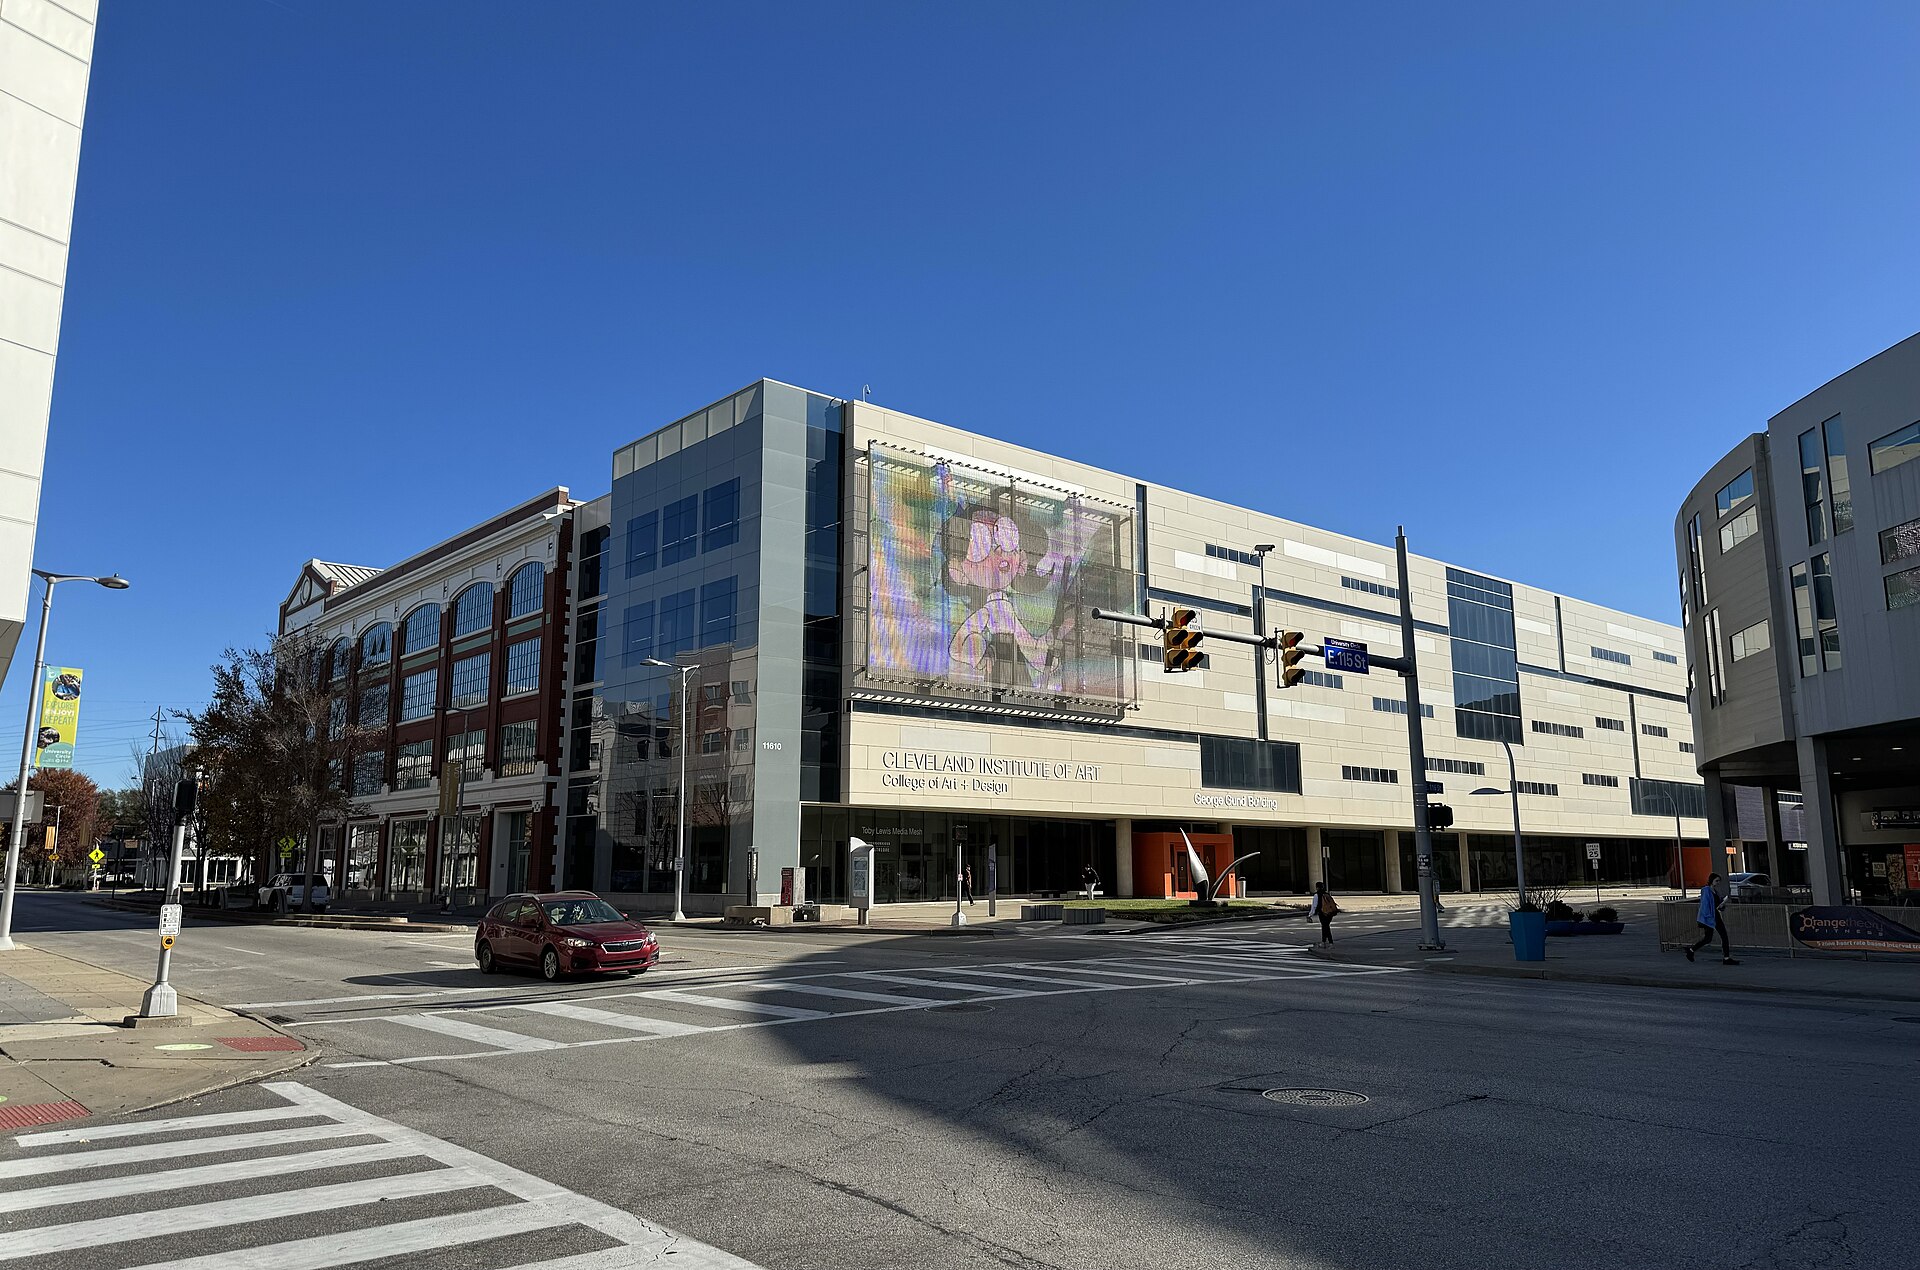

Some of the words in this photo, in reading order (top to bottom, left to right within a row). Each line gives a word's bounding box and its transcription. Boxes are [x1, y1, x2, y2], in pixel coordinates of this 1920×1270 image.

[1354, 654, 1367, 670] St
[44, 715, 74, 725] REPEAT!
[762, 742, 782, 750] 11610
[882, 751, 974, 773] CLEVELAND
[979, 757, 1050, 778] INSTITUTE
[1053, 762, 1072, 779] OF
[1075, 764, 1102, 781] ART
[882, 773, 925, 791] College
[928, 775, 940, 789] of
[941, 776, 957, 790] Art
[960, 780, 969, 789] +
[972, 778, 1008, 795] Design
[1194, 792, 1223, 808] George
[1224, 794, 1246, 807] Gund
[1247, 795, 1277, 811] Building
[862, 826, 875, 836] Toby
[875, 826, 891, 835] Lewis
[892, 827, 908, 835] Media
[909, 827, 923, 836] Mesh
[1589, 850, 1599, 858] 25
[1800, 914, 1883, 932] Orangetheory
[1815, 929, 1883, 937] FITNESS
